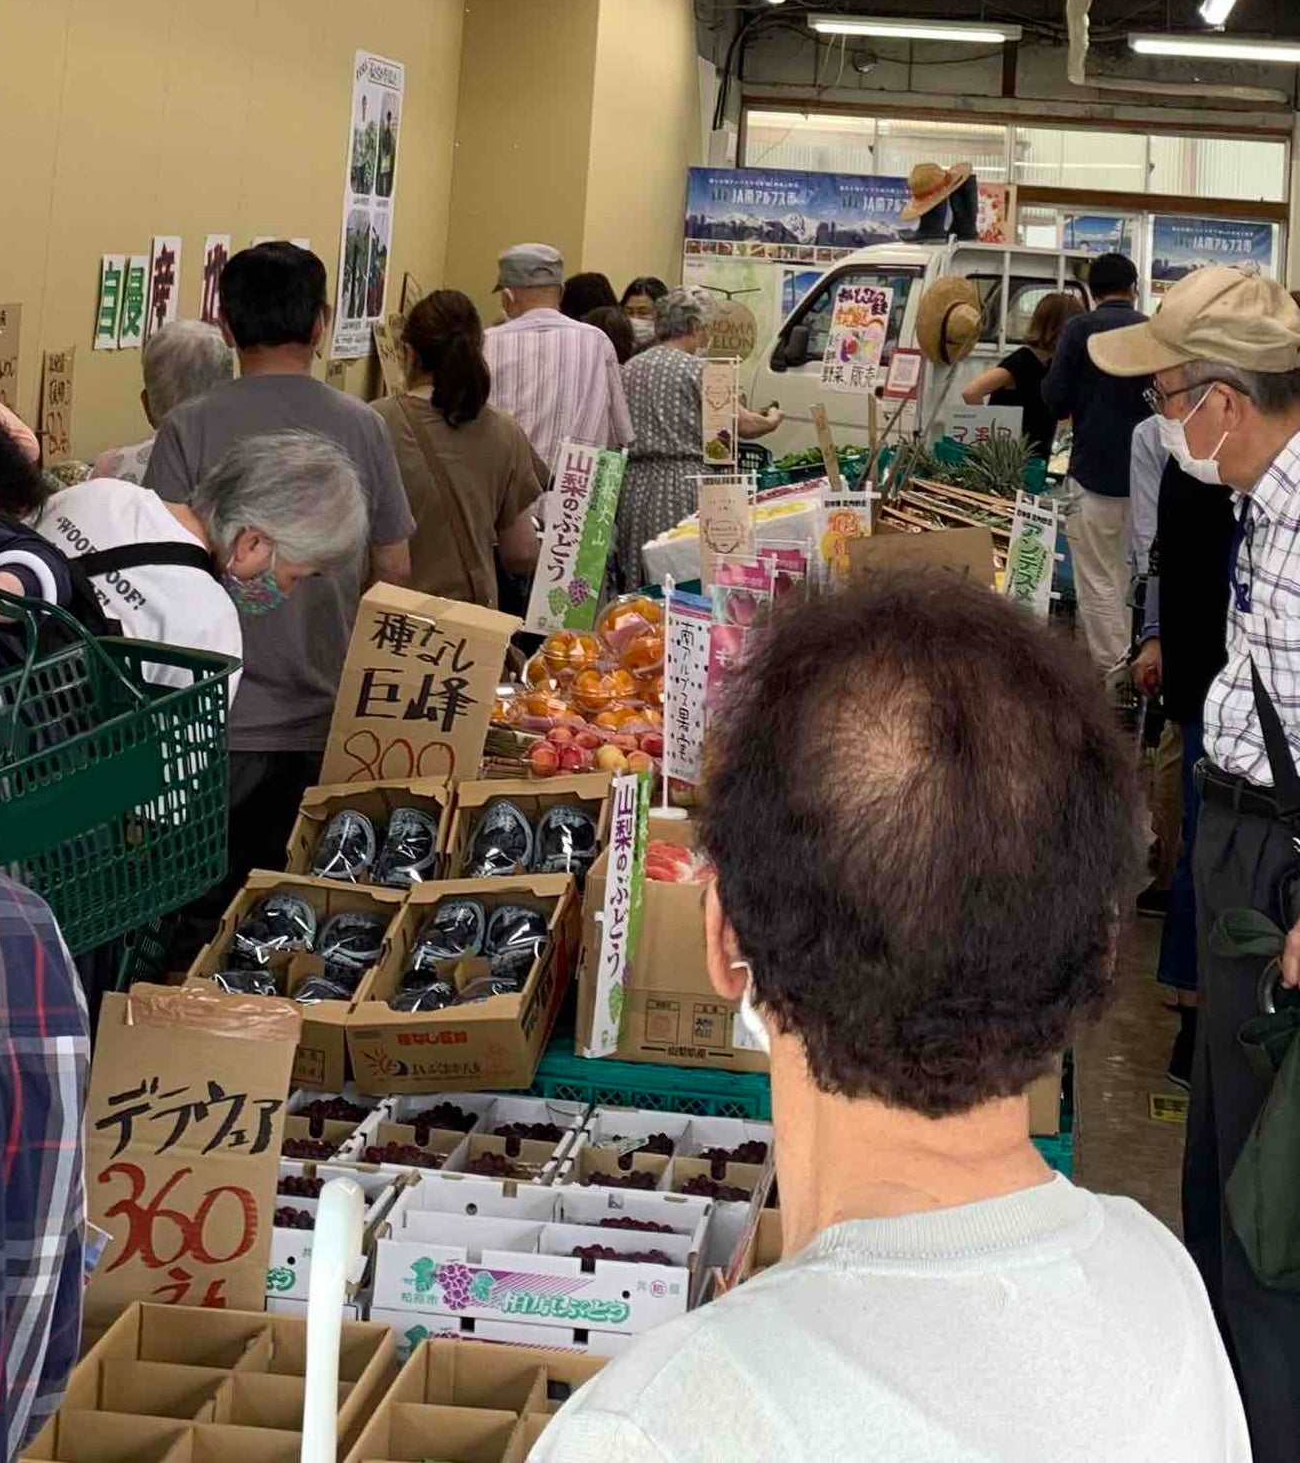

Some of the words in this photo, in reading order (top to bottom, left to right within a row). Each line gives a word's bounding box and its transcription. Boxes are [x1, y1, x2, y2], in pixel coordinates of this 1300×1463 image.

[547, 450, 594, 582] 山梨のぶどう
[371, 611, 476, 673] 種なし
[355, 667, 479, 733] 巨峰
[606, 784, 636, 978] 山梨のぶどう
[94, 1076, 284, 1160] デラウェア
[97, 1162, 259, 1274] 360
